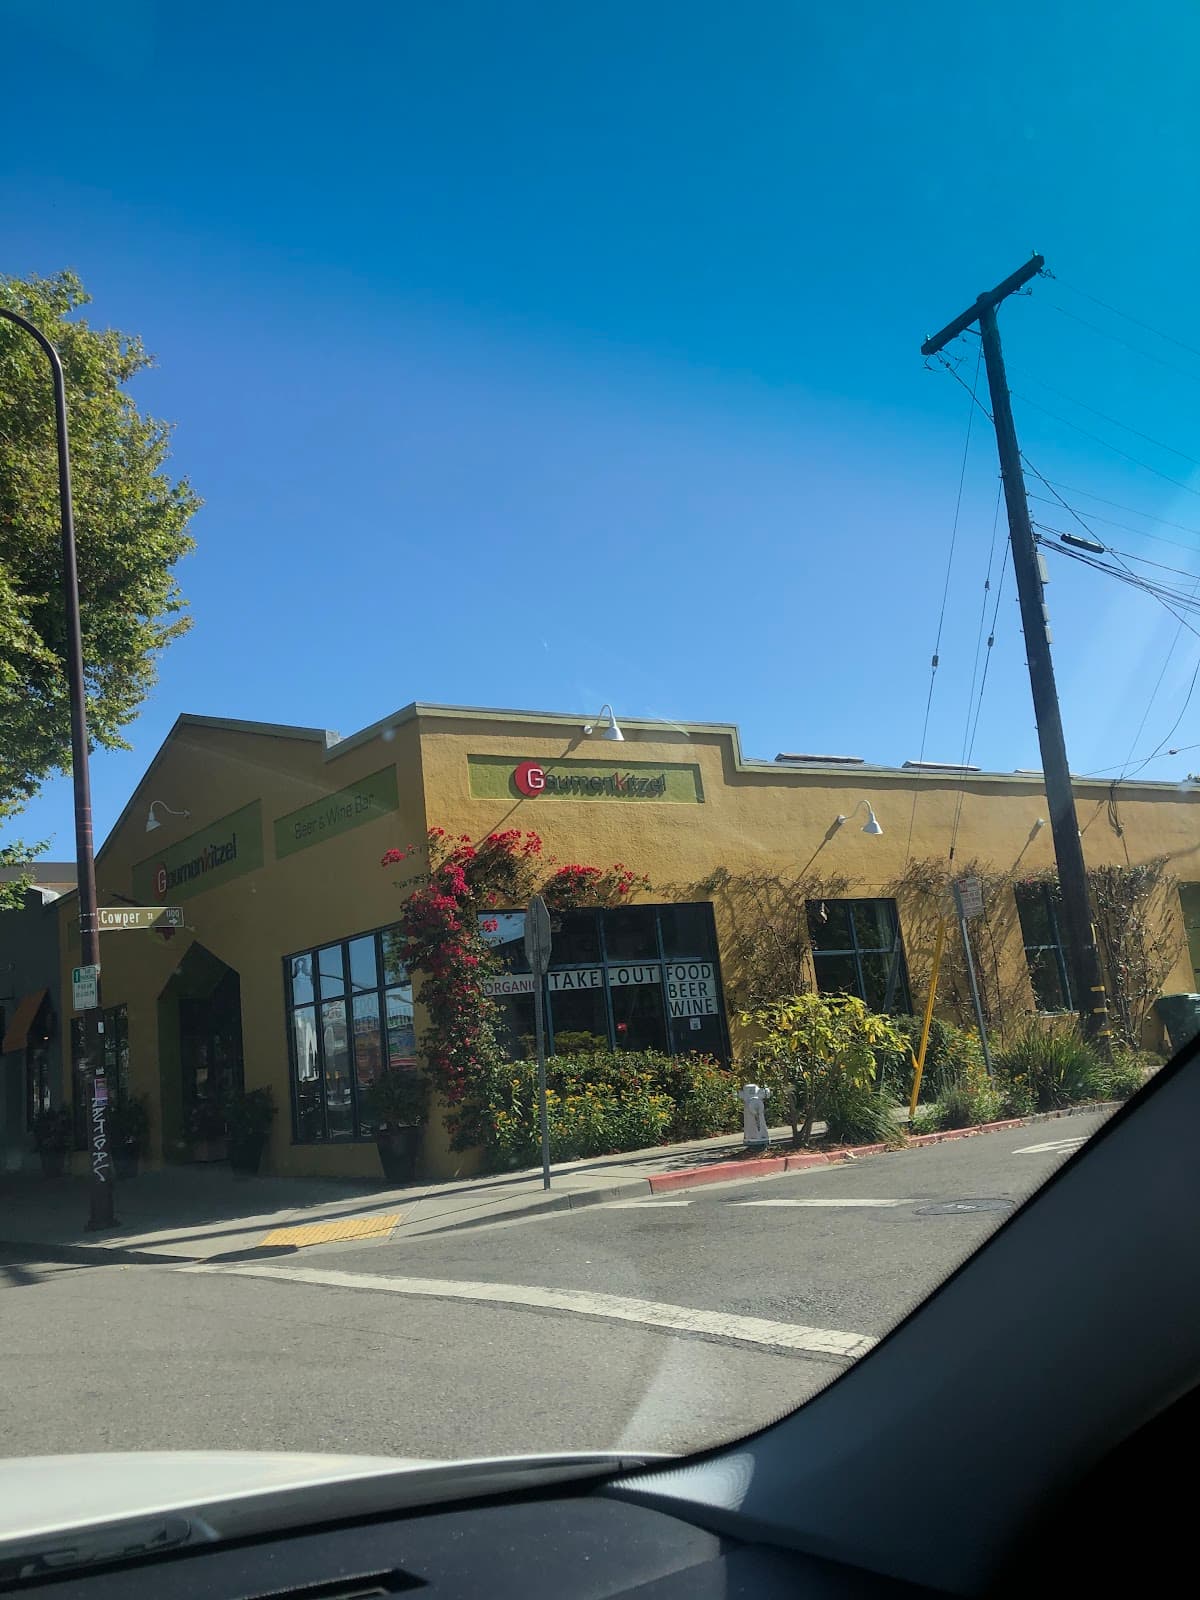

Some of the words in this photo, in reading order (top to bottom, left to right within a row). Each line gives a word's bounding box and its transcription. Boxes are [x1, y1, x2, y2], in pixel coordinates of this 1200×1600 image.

[294, 819, 317, 840] Beer
[326, 803, 352, 825] Wine
[354, 792, 374, 814] Bar
[101, 911, 140, 926] Cowper
[551, 971, 599, 989] TAKE
[666, 965, 711, 980] FOOD
[668, 982, 707, 998] BEER
[669, 999, 714, 1016] WINE
